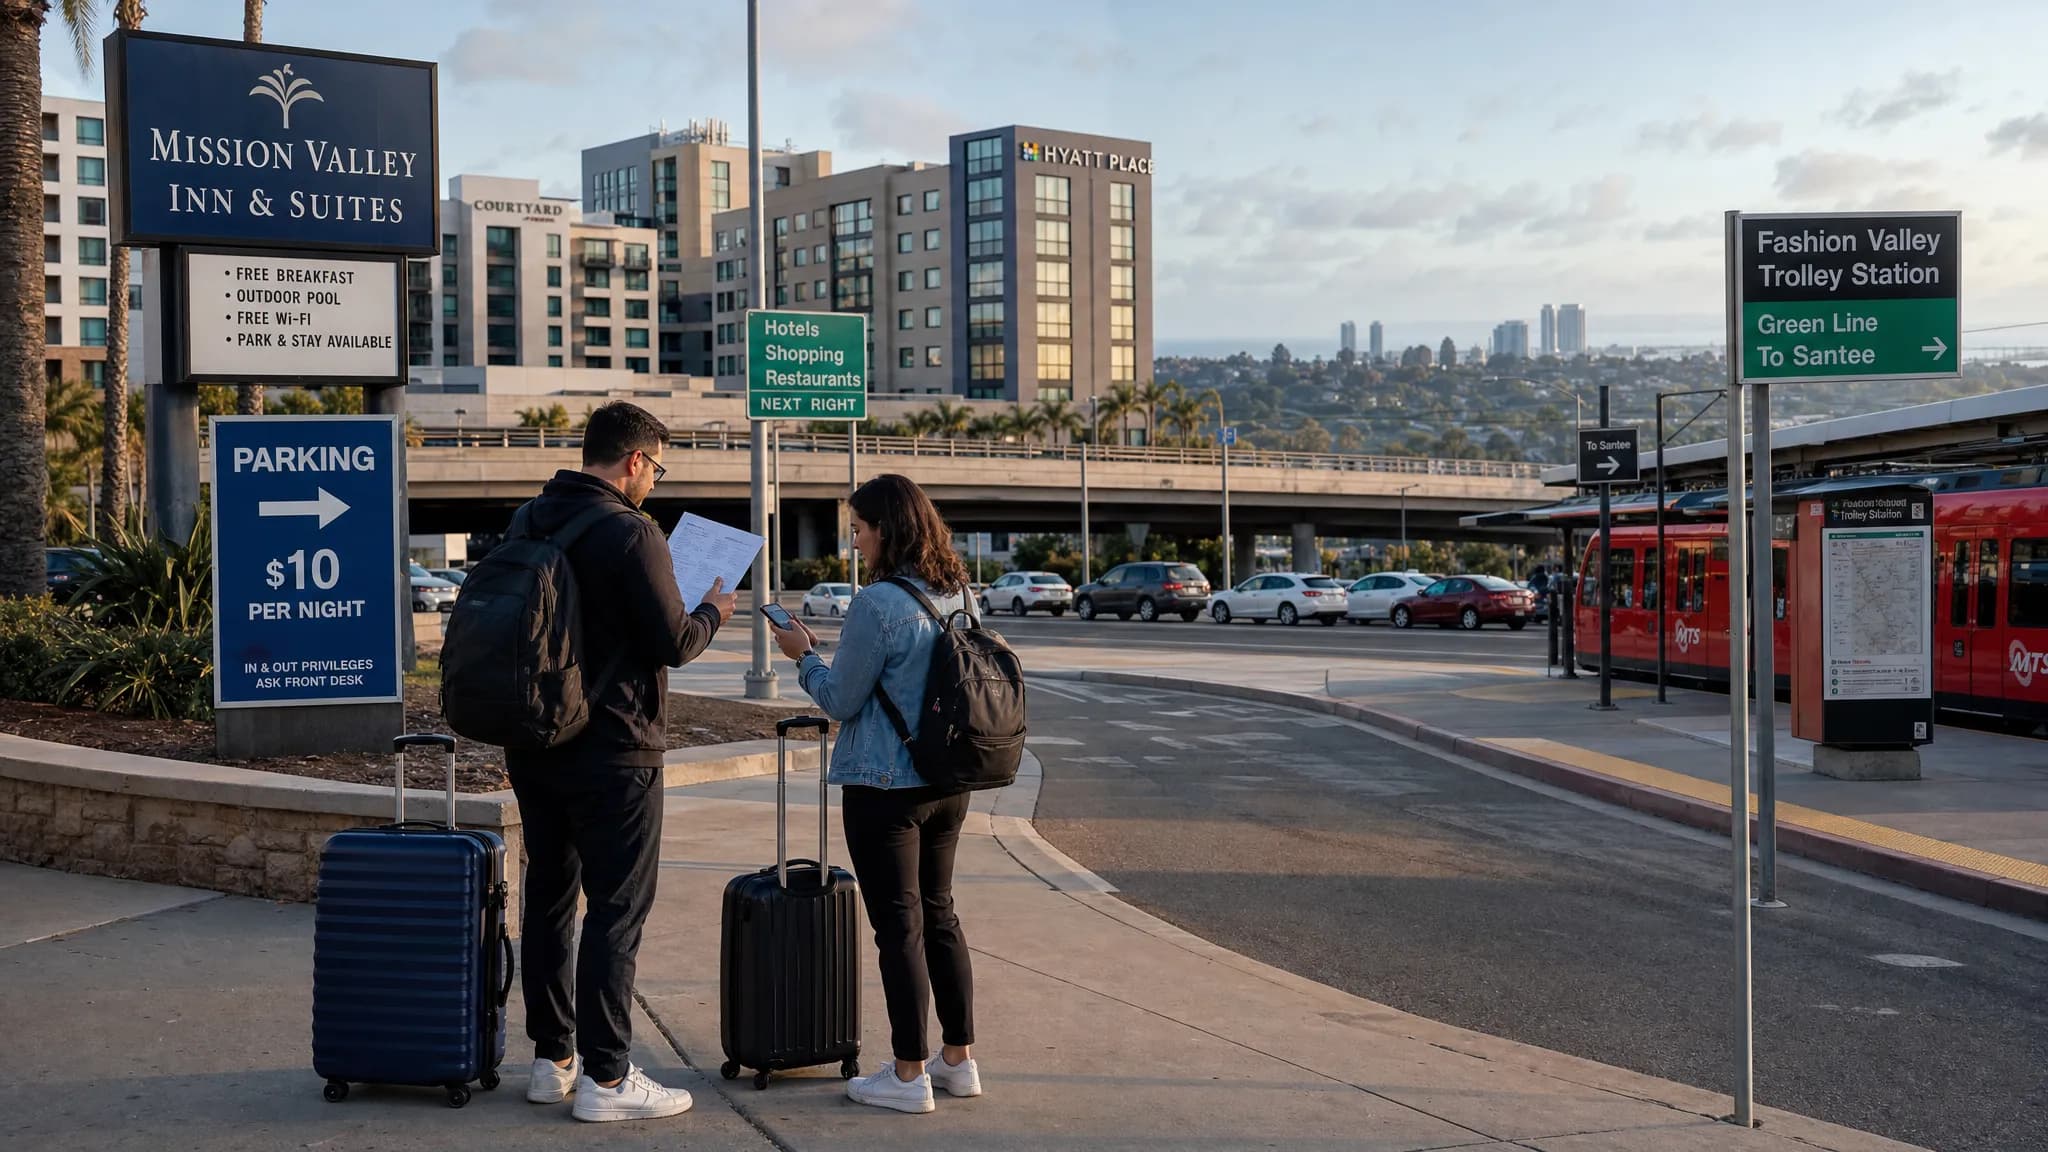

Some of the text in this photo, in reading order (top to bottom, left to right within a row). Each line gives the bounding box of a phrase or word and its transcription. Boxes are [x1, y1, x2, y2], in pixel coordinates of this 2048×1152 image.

[150, 127, 417, 178] MISSION VALLEY
[1043, 144, 1157, 174] HYATT PLACE
[169, 183, 404, 224] INN & SUITES
[474, 200, 562, 216] COURTYARD
[1758, 228, 1941, 256] Fashion Valley
[236, 267, 355, 285] FREE BREAKFAST
[1758, 262, 1940, 291] Trolley Station
[236, 289, 341, 305] OUTDOOR POOL
[237, 311, 269, 325] FREE
[1758, 313, 1878, 334] Green Line
[765, 319, 820, 337] Hotels
[237, 333, 392, 349] PARK & STAY AVAILABLE
[765, 344, 844, 366] Shopping
[1757, 345, 1876, 367] To Santee
[765, 369, 862, 387] Restaurants
[761, 397, 857, 412] NEXT RIGHT
[1586, 440, 1631, 451] To Santee
[234, 446, 375, 473] PARKING
[266, 549, 340, 590] $10
[249, 600, 366, 620] PER NIGHT
[1676, 627, 1701, 645] MTS
[245, 659, 374, 674] IN & OUT PRIVILEGES
[256, 674, 363, 688] ASK FRONT DESK
